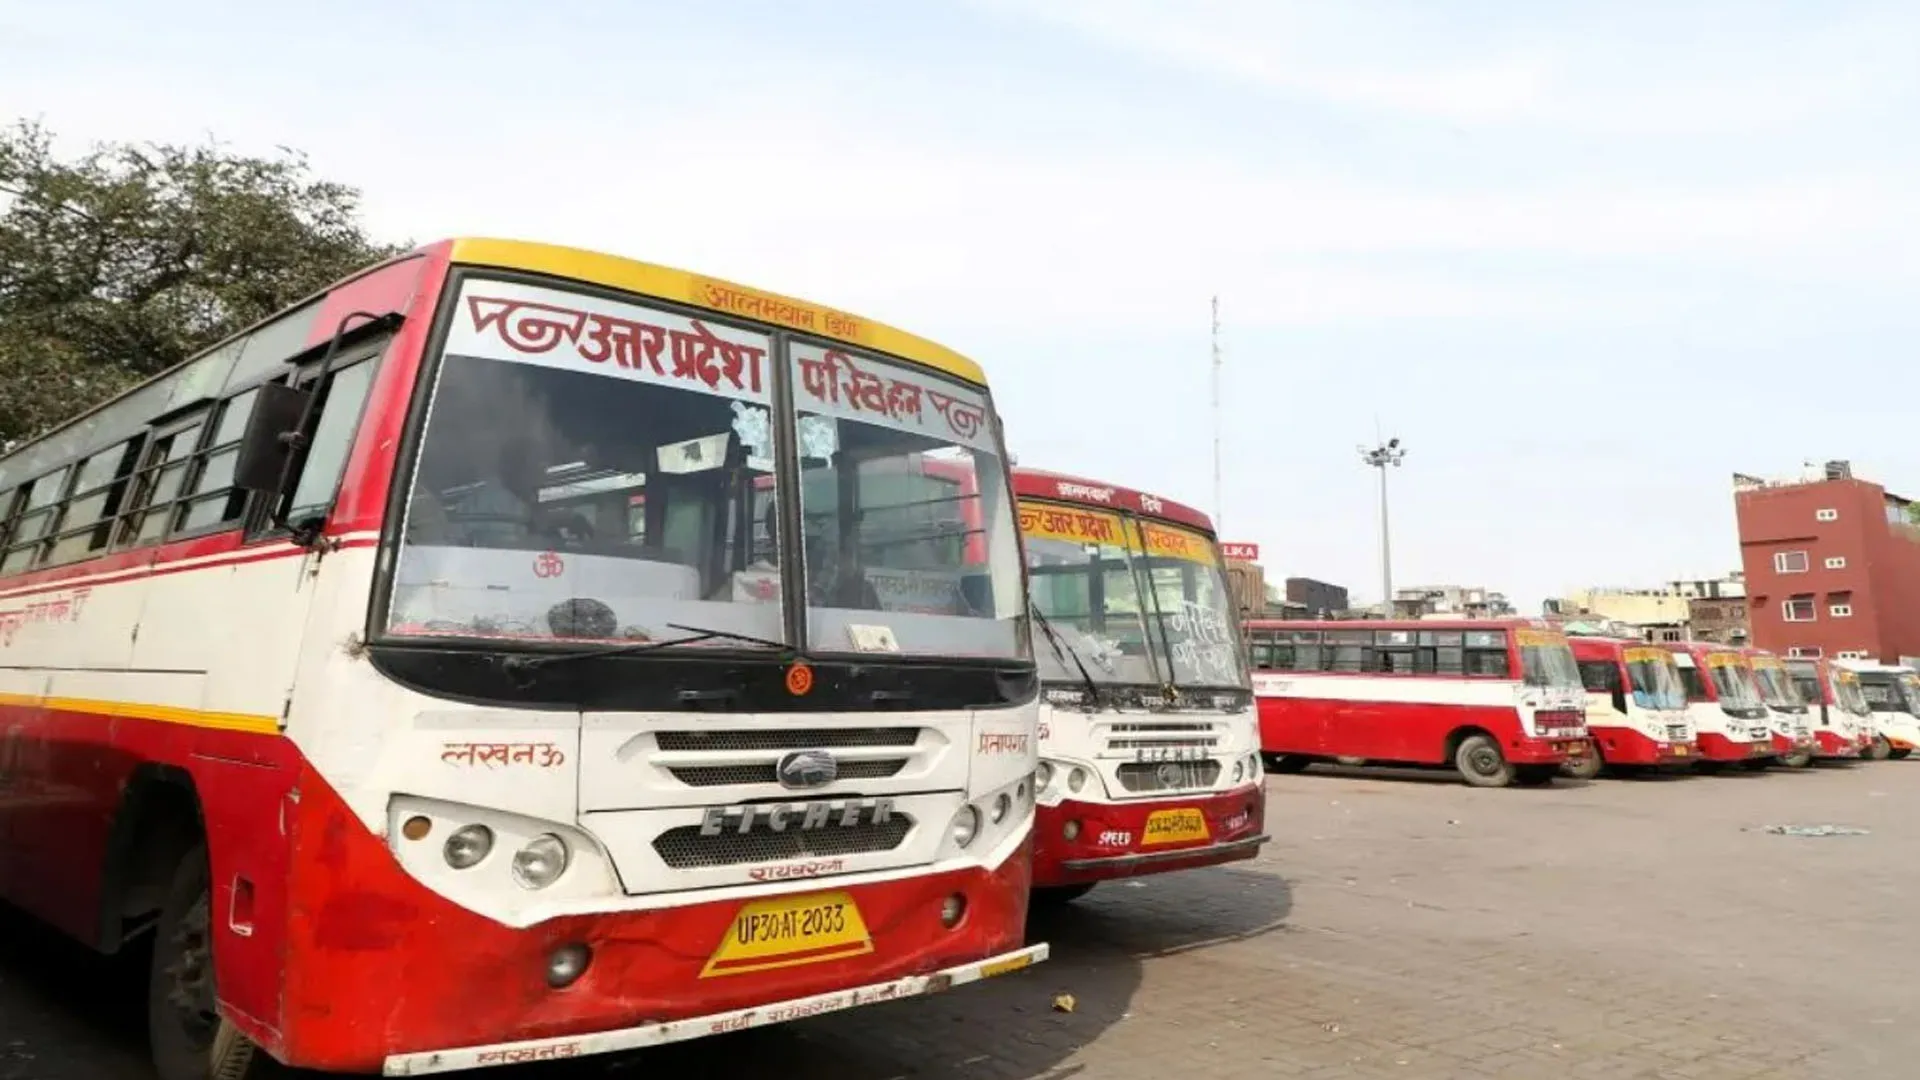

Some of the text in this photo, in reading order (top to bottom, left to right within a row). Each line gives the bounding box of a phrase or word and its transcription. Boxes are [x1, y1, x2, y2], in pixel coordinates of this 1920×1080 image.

[578, 313, 767, 393] उत्तर प्रदेश
[798, 350, 923, 425] परिवहन
[440, 742, 564, 770] लखनऊ
[700, 799, 894, 836] EICHER
[1099, 831, 1132, 847] SPEED
